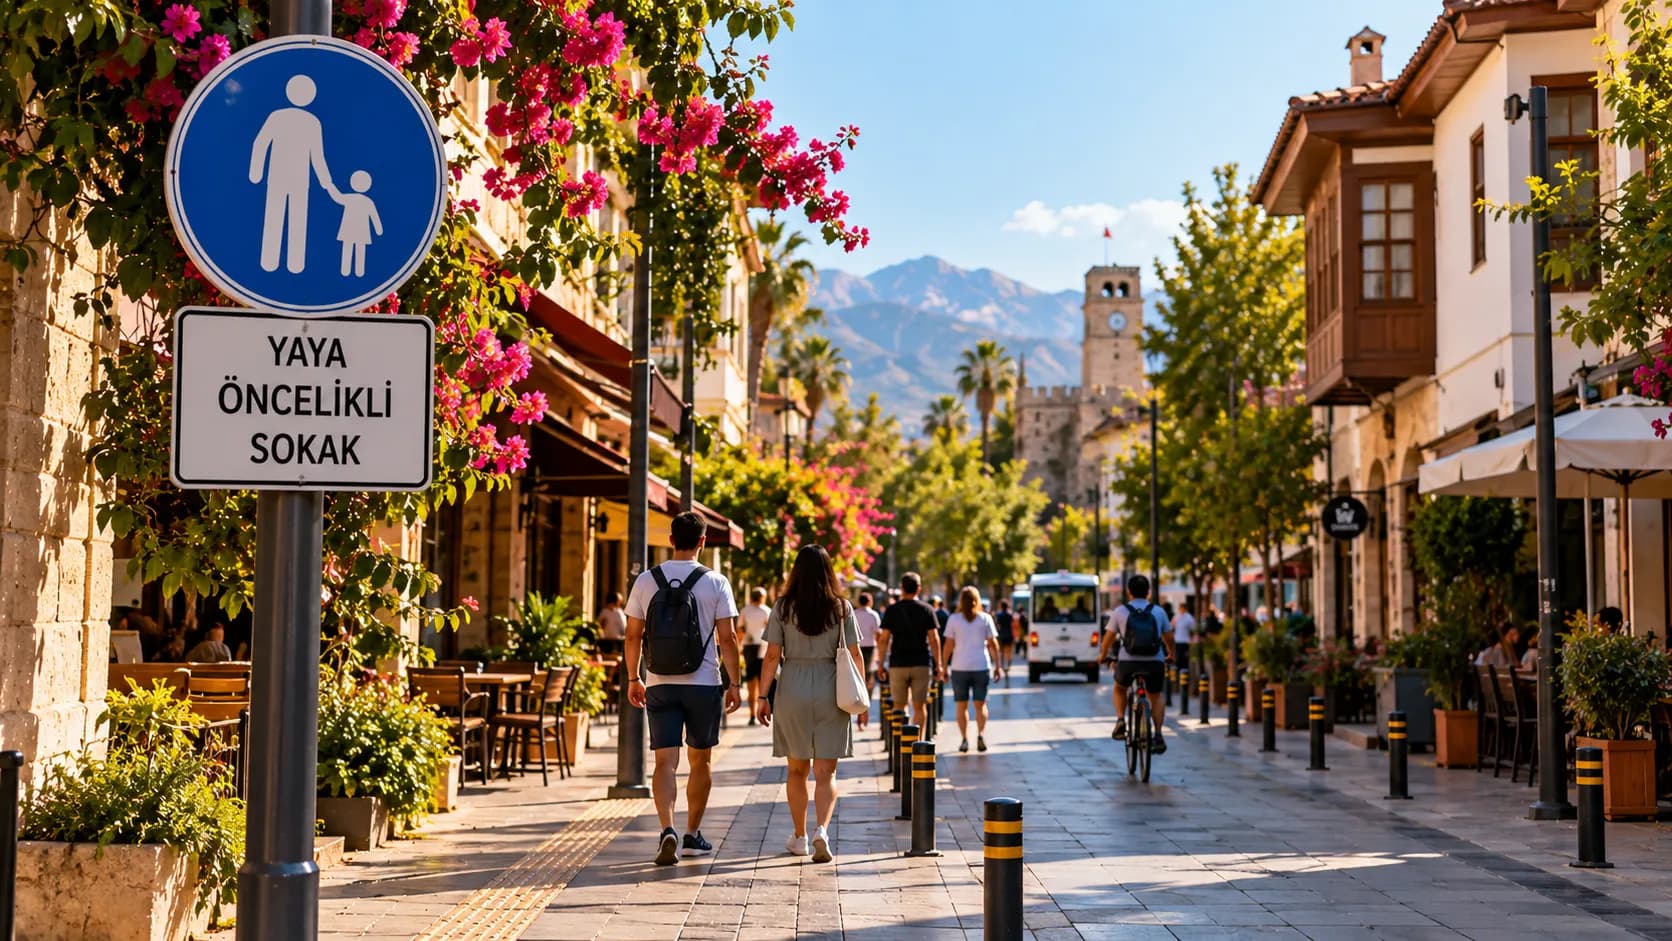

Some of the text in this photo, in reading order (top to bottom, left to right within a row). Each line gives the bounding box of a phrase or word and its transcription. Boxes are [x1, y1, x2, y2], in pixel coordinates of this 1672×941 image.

[267, 335, 347, 369] YAYA
[218, 375, 392, 418] ÖNCELİKLİ
[250, 432, 361, 466] SOKAK
